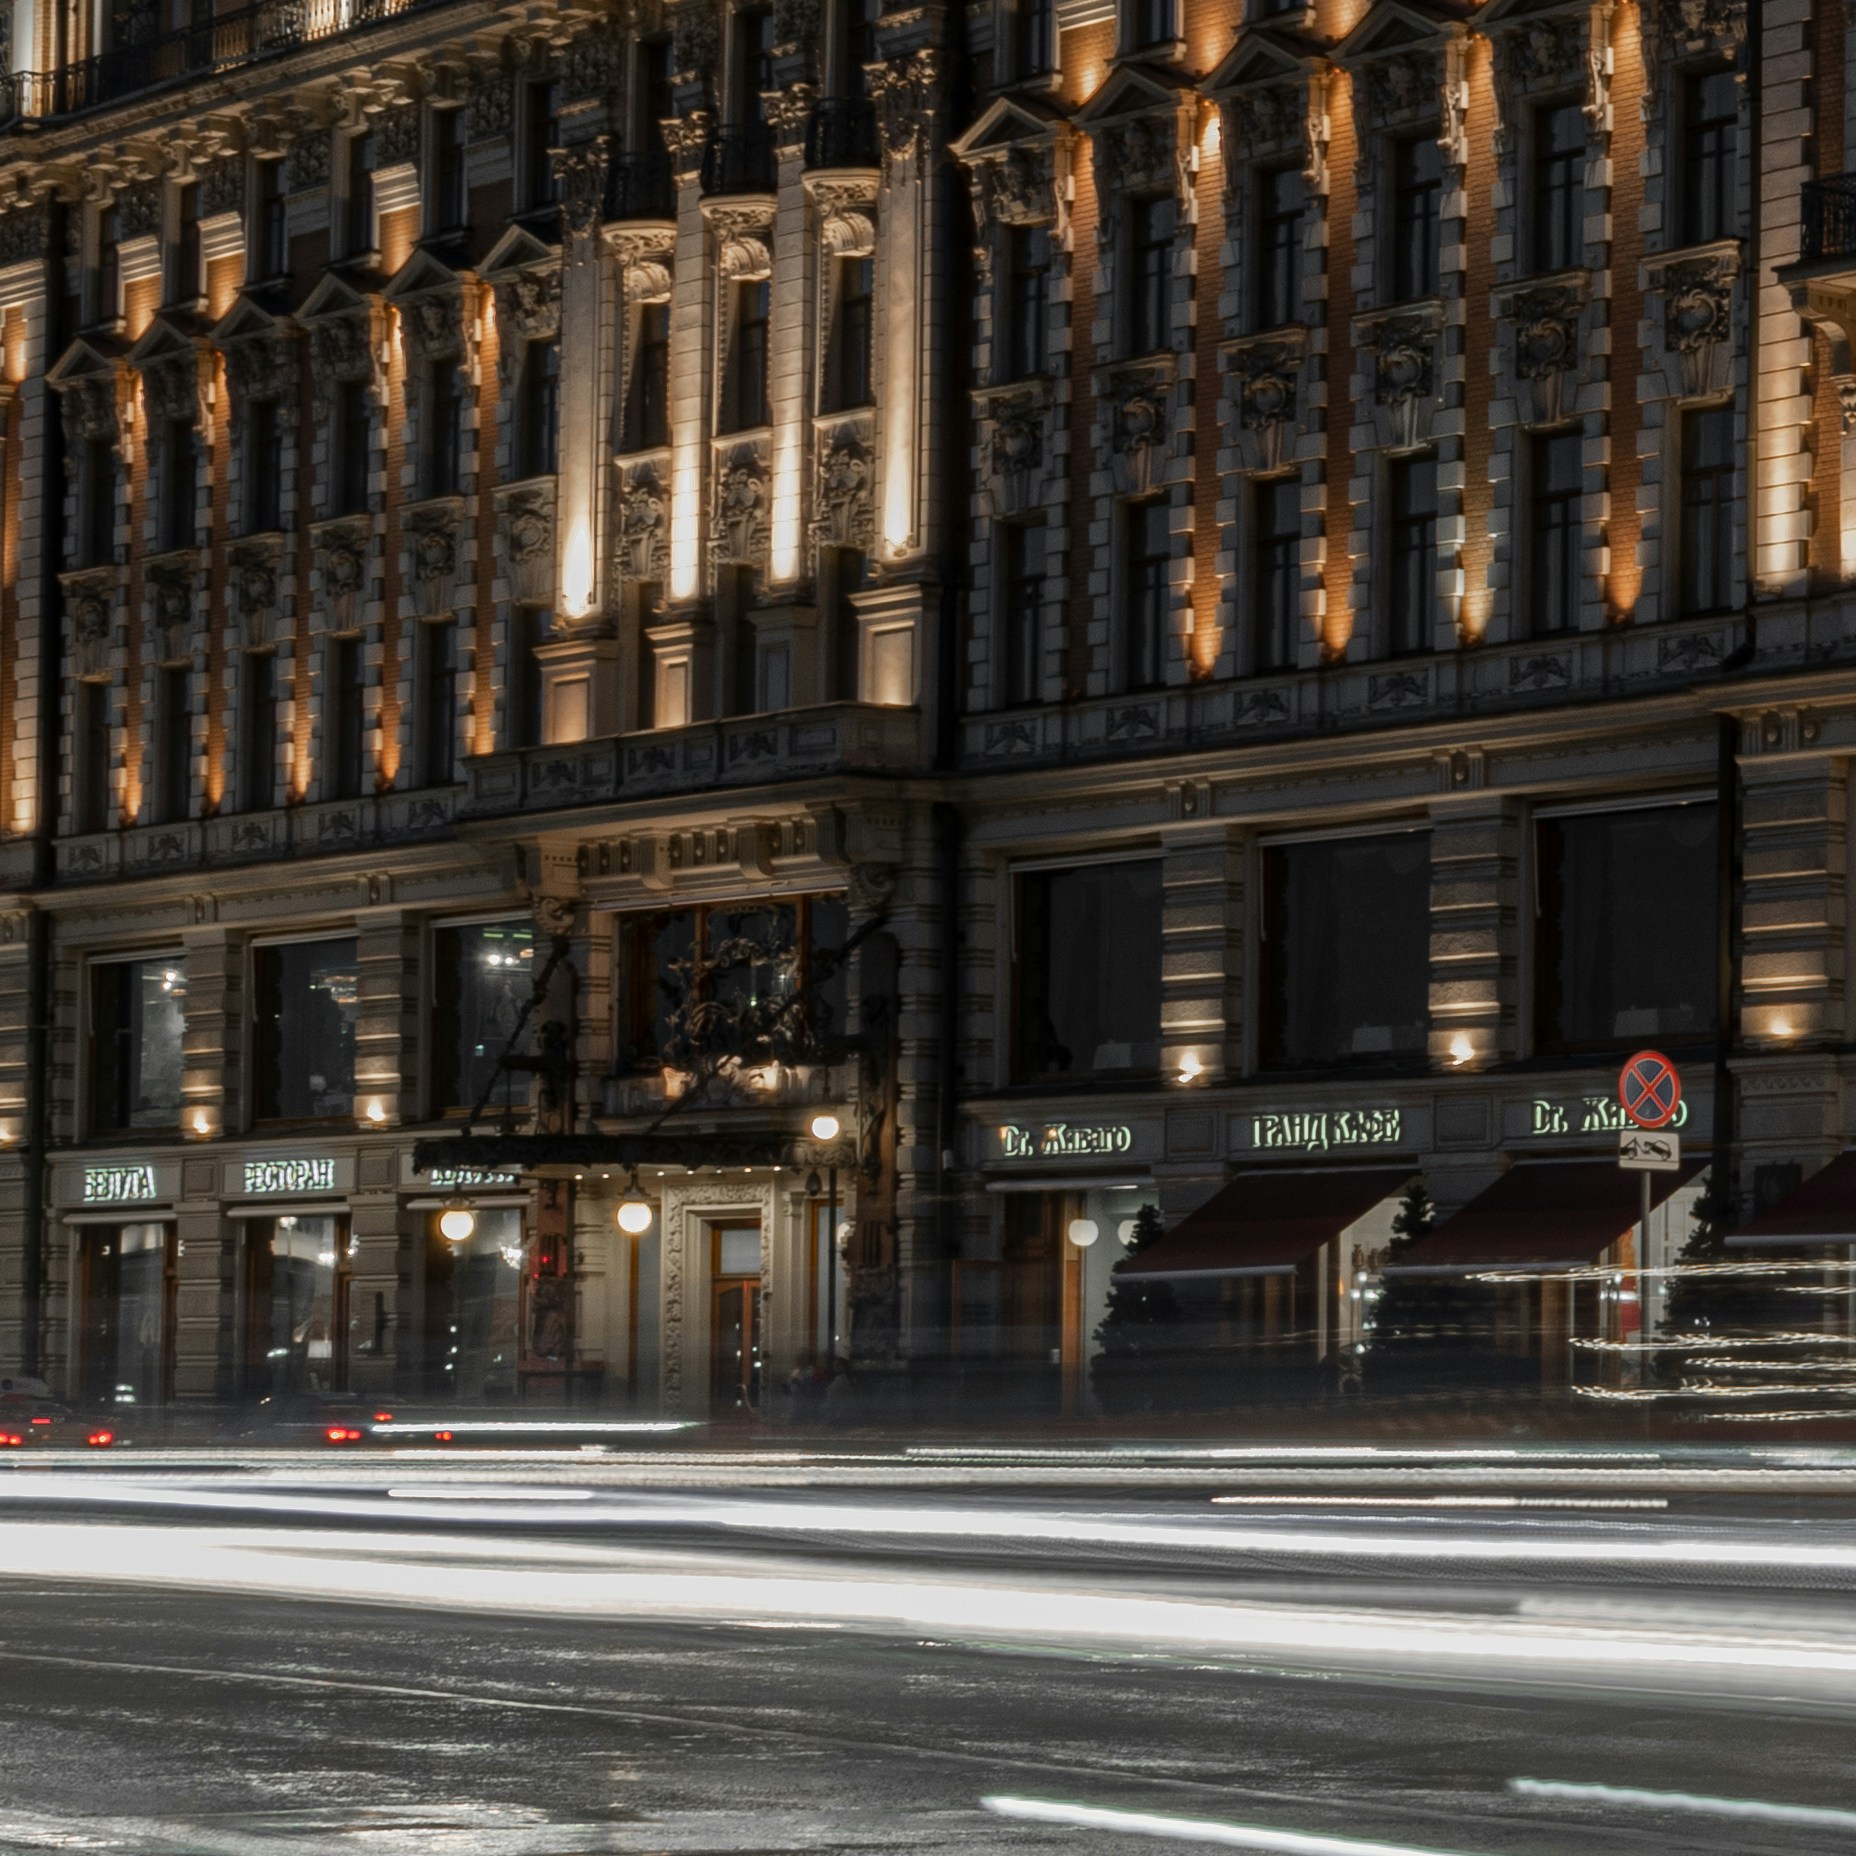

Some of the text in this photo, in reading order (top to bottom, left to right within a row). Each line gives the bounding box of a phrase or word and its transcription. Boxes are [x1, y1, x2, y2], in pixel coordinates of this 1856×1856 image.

[1252, 1109, 1401, 1152] ГРАНД КАФЕ
[244, 1158, 336, 1192] РЕСТОРАН
